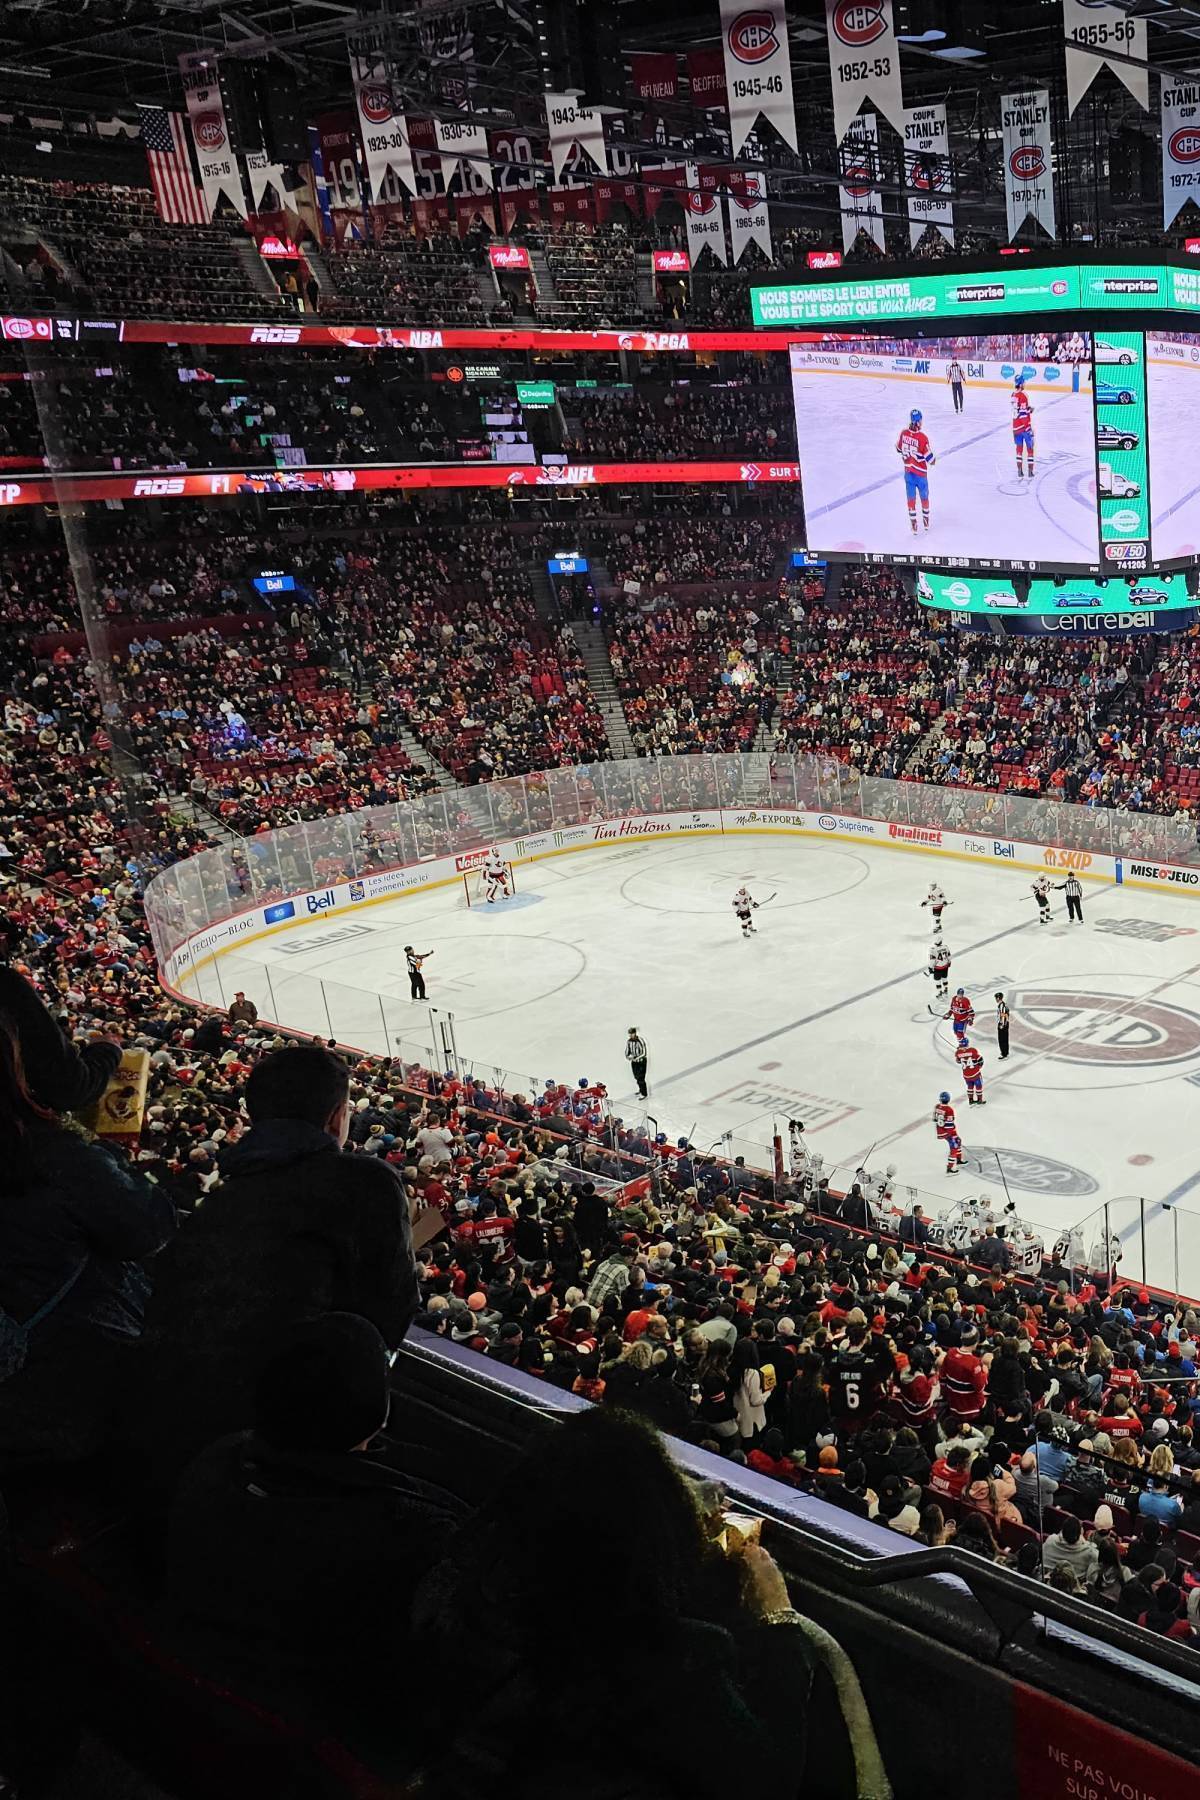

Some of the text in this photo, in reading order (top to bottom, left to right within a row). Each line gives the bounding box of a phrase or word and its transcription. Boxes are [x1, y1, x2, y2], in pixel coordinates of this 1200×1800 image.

[1071, 20, 1136, 46] 1955-56
[837, 58, 891, 83] 1952-53
[733, 75, 783, 98] 1945-46
[1012, 96, 1037, 108] COUPE
[551, 108, 594, 125] 1943-44
[912, 109, 936, 121] COUPE
[1004, 107, 1047, 127] STANLEY
[1180, 107, 1197, 118] CUP
[904, 119, 946, 139] STANLEY
[1019, 127, 1034, 137] CUP
[367, 135, 402, 152] 1929-30
[919, 139, 933, 149] CUP
[496, 137, 536, 193] 29
[1010, 189, 1047, 202] 1970-71
[690, 222, 719, 235] 1964-65
[735, 216, 766, 229] 1965-66
[1172, 272, 1197, 289] NOUS
[758, 283, 911, 306] NOUS SOMMES LE LIEN ENTRE
[1173, 288, 1197, 305] VOUS
[760, 304, 791, 319] VOUS
[791, 304, 805, 319] ET
[806, 303, 819, 318] LE
[819, 301, 855, 317] SPORT
[855, 300, 879, 316] QUE
[250, 328, 301, 343] RDS
[409, 330, 443, 347] NBA
[658, 333, 689, 349] PGA
[968, 363, 984, 378] Bell
[567, 466, 596, 482] NFL
[769, 467, 790, 478] SUR
[134, 480, 186, 496] RDS
[210, 476, 230, 493] F1
[1108, 544, 1144, 557] 50/50
[560, 561, 576, 573] Bell
[1010, 560, 1025, 571] MTL
[266, 577, 283, 591] Bell
[592, 823, 616, 840] Tim
[619, 820, 671, 838] Hortons
[821, 818, 834, 827] Esso
[888, 824, 943, 844] Qualinet
[964, 839, 1015, 859] Fibe Bell
[1056, 850, 1092, 871] SKIP
[368, 871, 405, 887] Les Idées
[369, 873, 429, 897] prennent vie ici
[306, 890, 335, 913] Bell
[1024, 1247, 1041, 1267] 27
[845, 1383, 860, 1409] 6
[1047, 1745, 1158, 1800] NE PAS VOU
